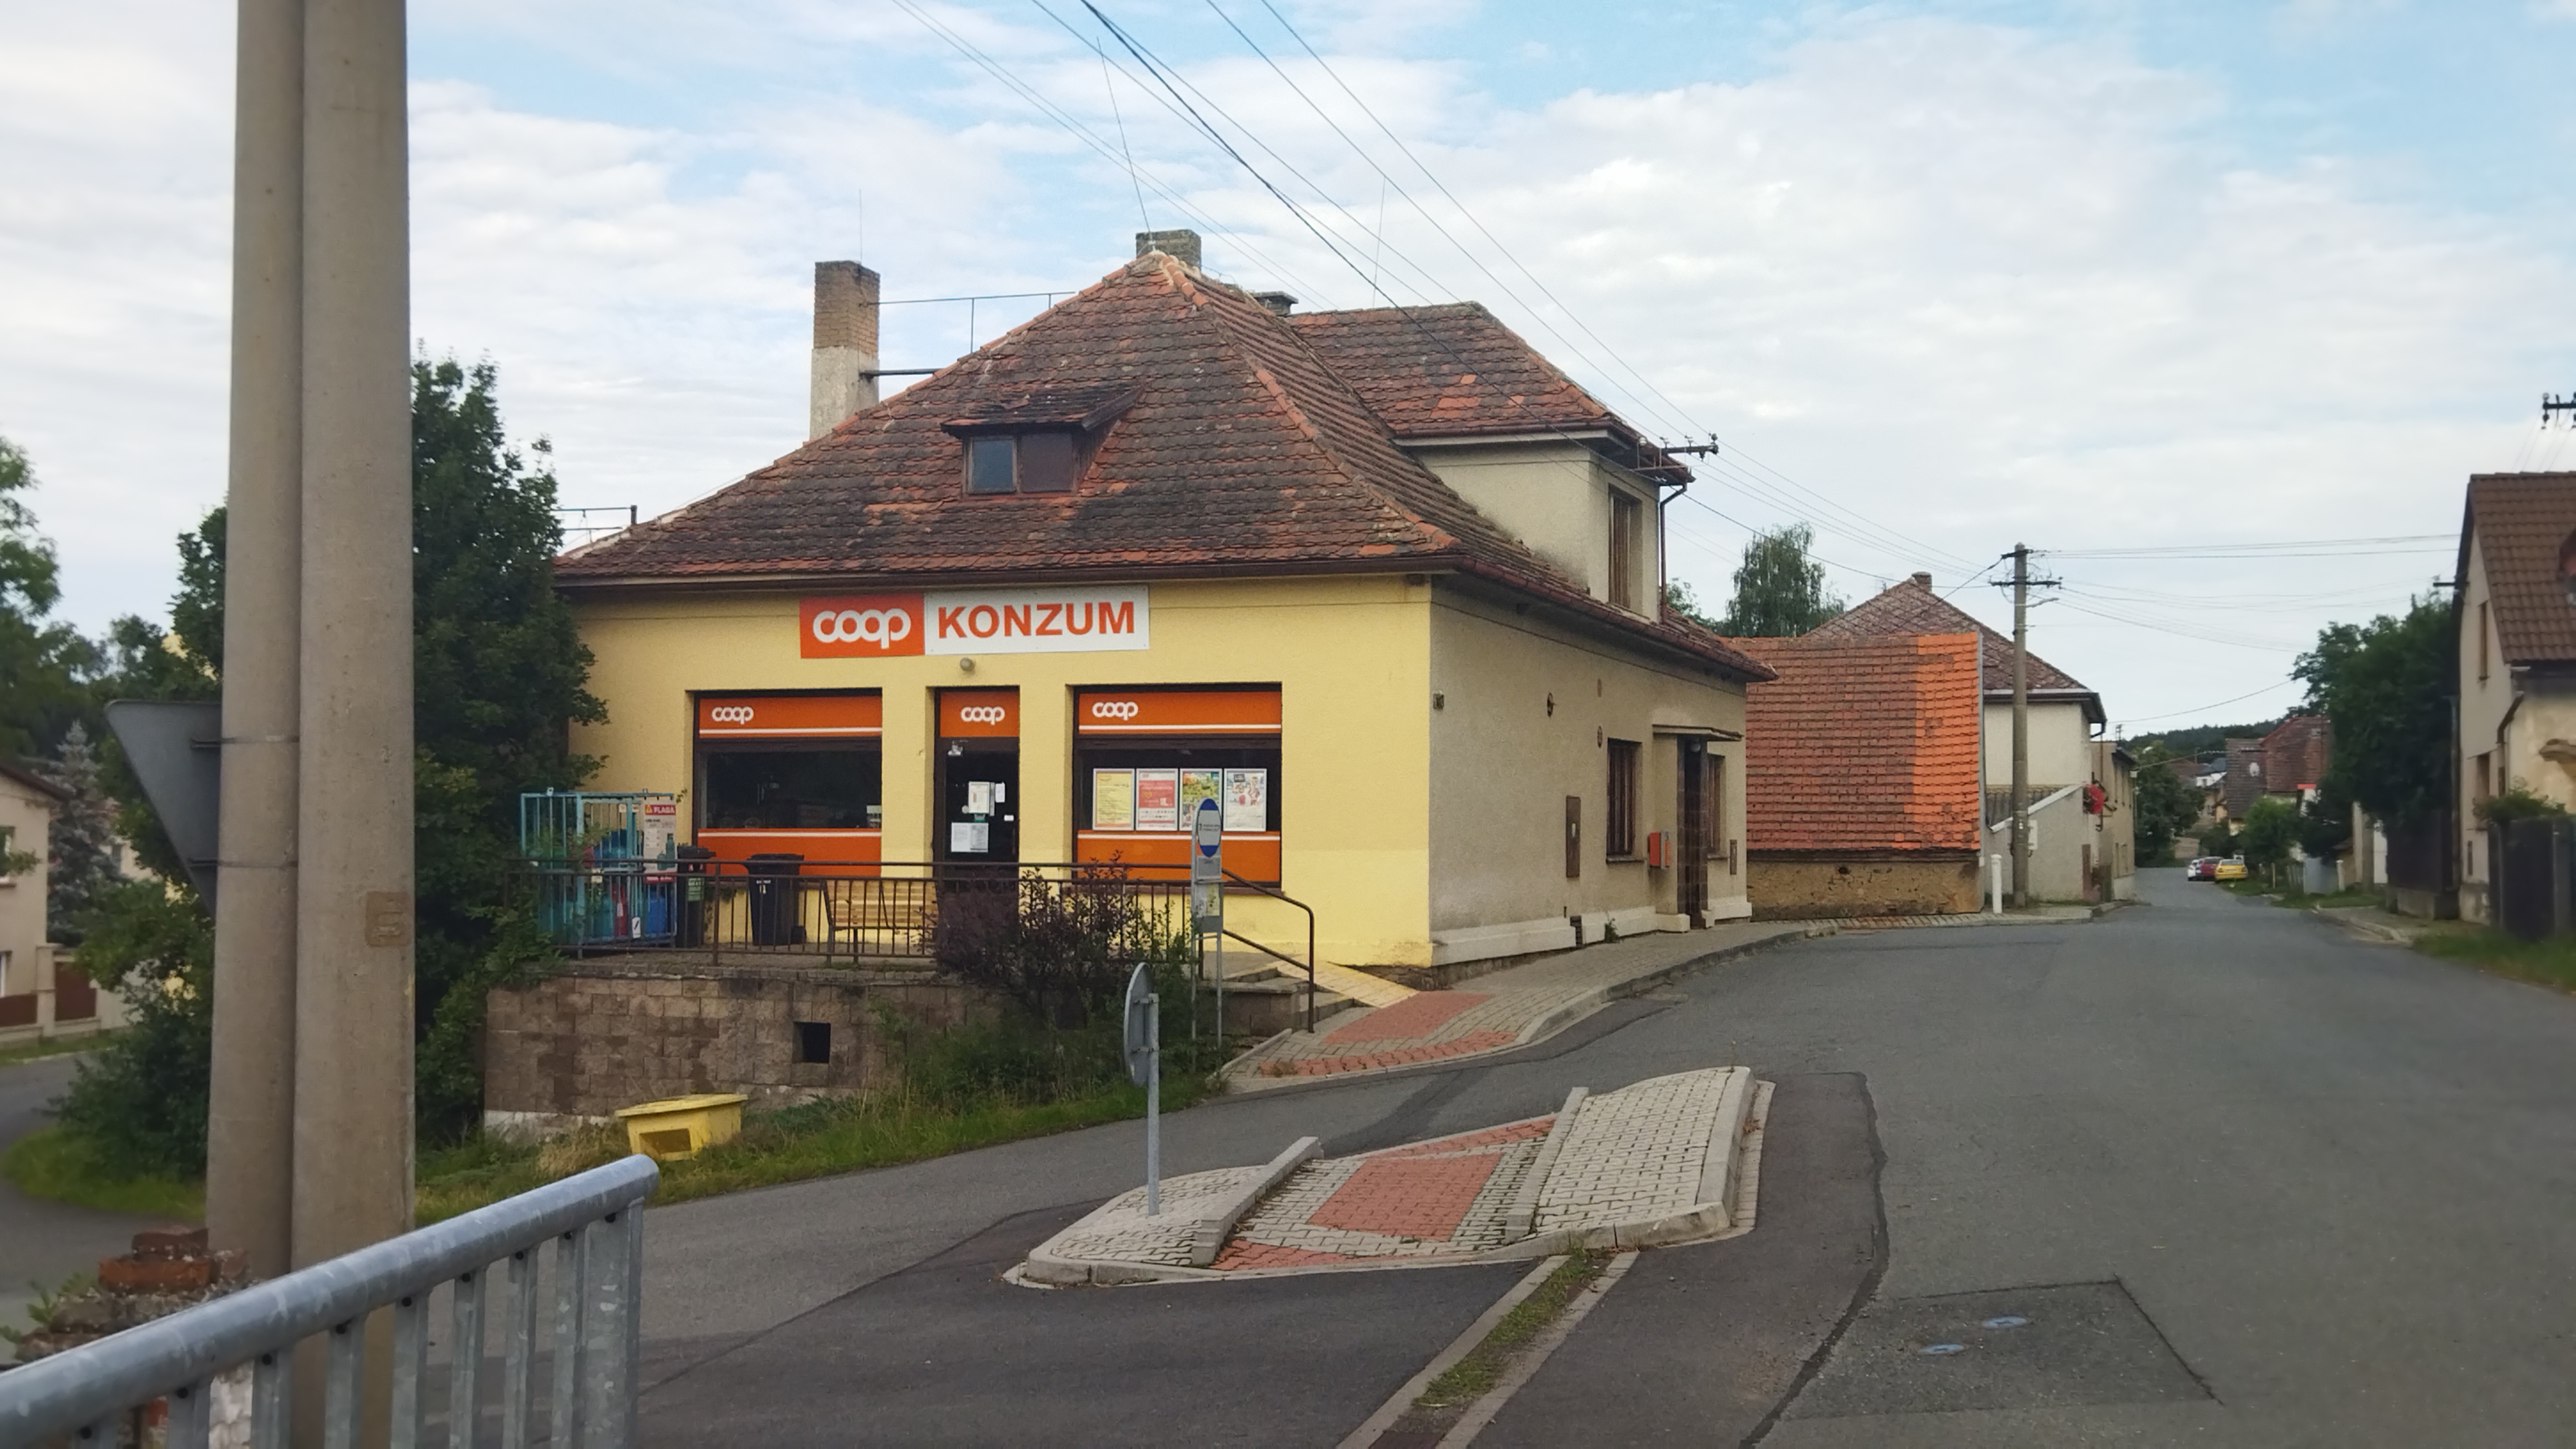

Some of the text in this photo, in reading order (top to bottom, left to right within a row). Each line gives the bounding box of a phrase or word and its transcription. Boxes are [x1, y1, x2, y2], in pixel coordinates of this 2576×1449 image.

[813, 600, 1134, 649] coop KONZUM
[712, 706, 753, 724] coop
[960, 706, 1005, 725] coop
[1092, 701, 1139, 721] coop
